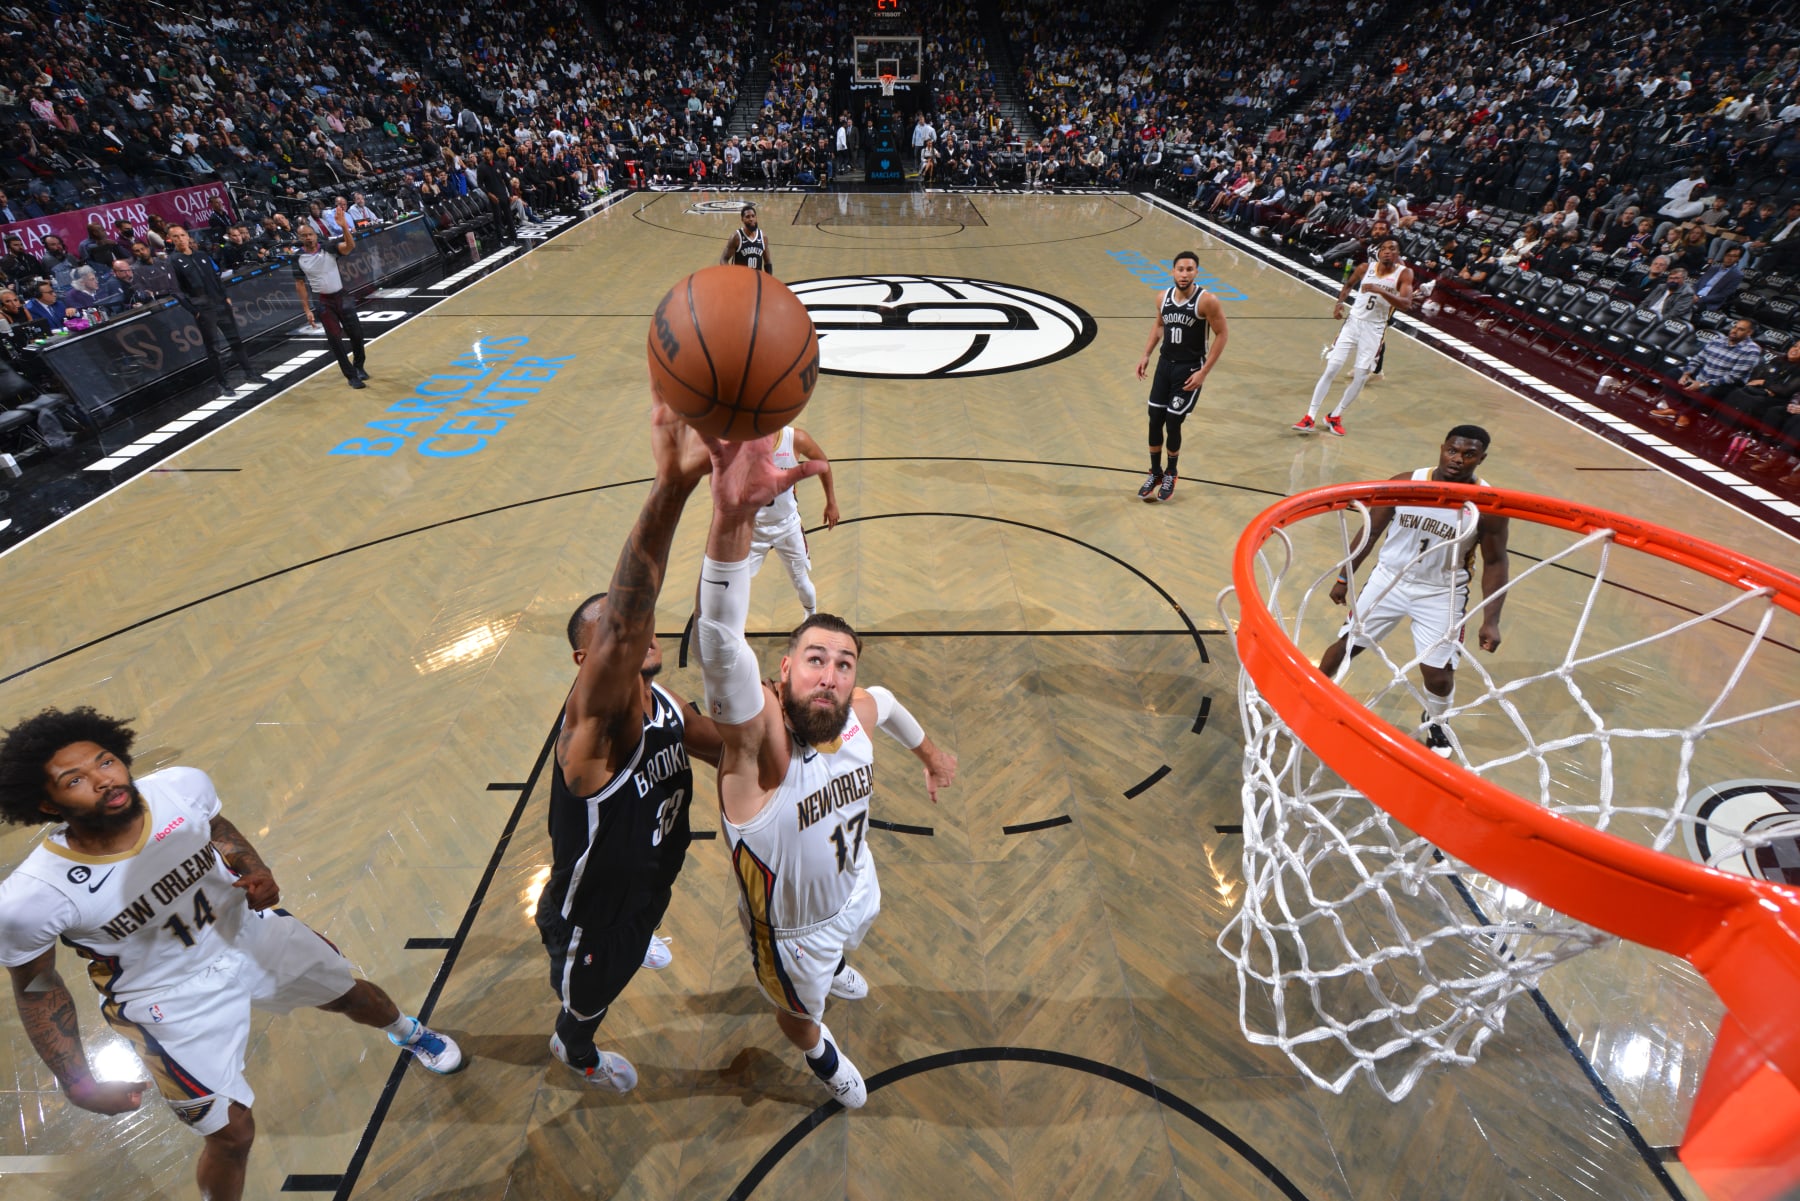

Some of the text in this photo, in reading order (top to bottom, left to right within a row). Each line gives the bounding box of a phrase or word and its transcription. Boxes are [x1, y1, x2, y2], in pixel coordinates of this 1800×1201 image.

[1, 223, 52, 255] TAR
[1366, 295, 1377, 310] 5
[1163, 313, 1196, 327] BROOKLYN
[1170, 327, 1182, 344] 10
[327, 336, 530, 457] BARCLAYS
[418, 354, 577, 458] CENTER
[1400, 513, 1457, 540] NEW ORLEAN
[1418, 538, 1430, 563] 1
[842, 724, 860, 742] ibotta
[797, 764, 874, 832] NEW ORLEA
[154, 816, 185, 842] ibotta
[652, 789, 684, 846] 33
[830, 809, 867, 874] 17
[71, 869, 89, 882] 6
[101, 894, 156, 941] NEW
[161, 888, 216, 948] 14
